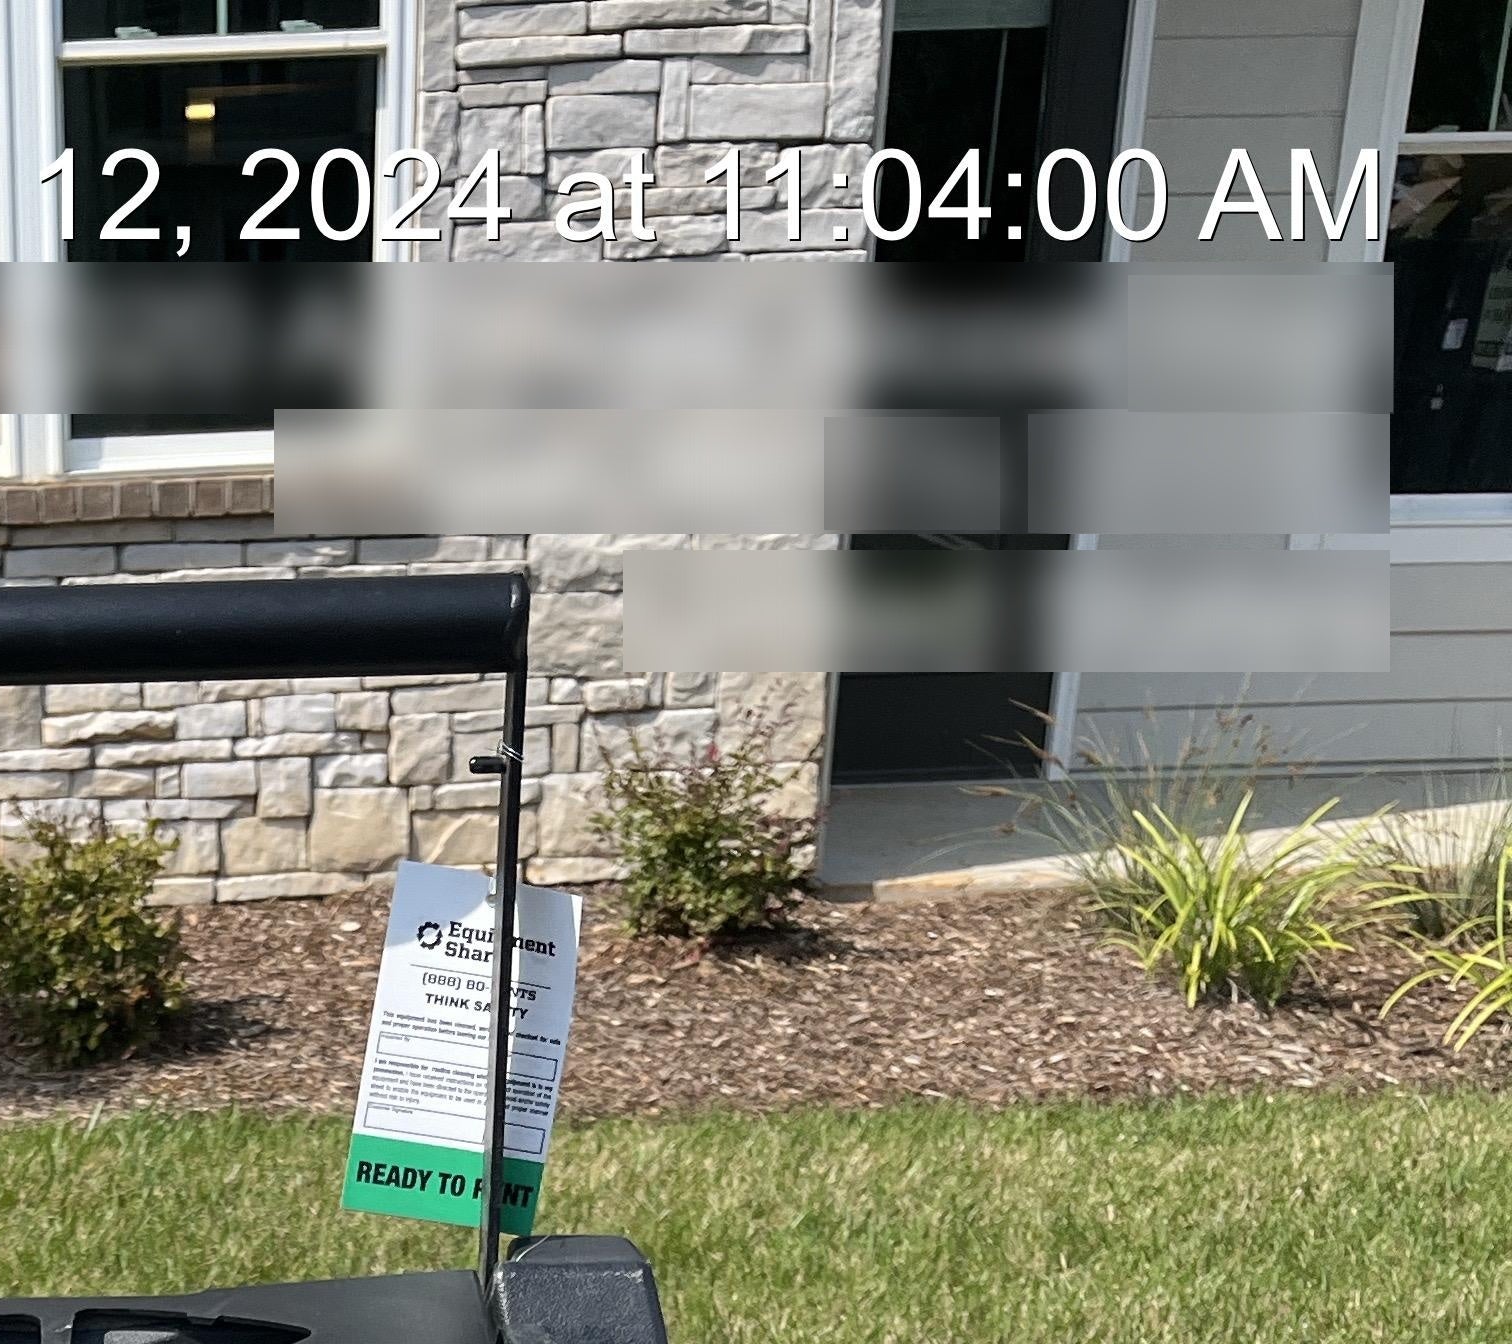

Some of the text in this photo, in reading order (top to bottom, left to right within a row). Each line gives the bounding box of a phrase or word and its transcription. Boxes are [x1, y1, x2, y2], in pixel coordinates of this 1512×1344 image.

[445, 941, 495, 963] Shar
[449, 921, 556, 957] Equiment
[422, 972, 462, 990] (888)
[425, 992, 529, 1019] THINK SATY
[356, 1160, 534, 1208] READY TO RNT
